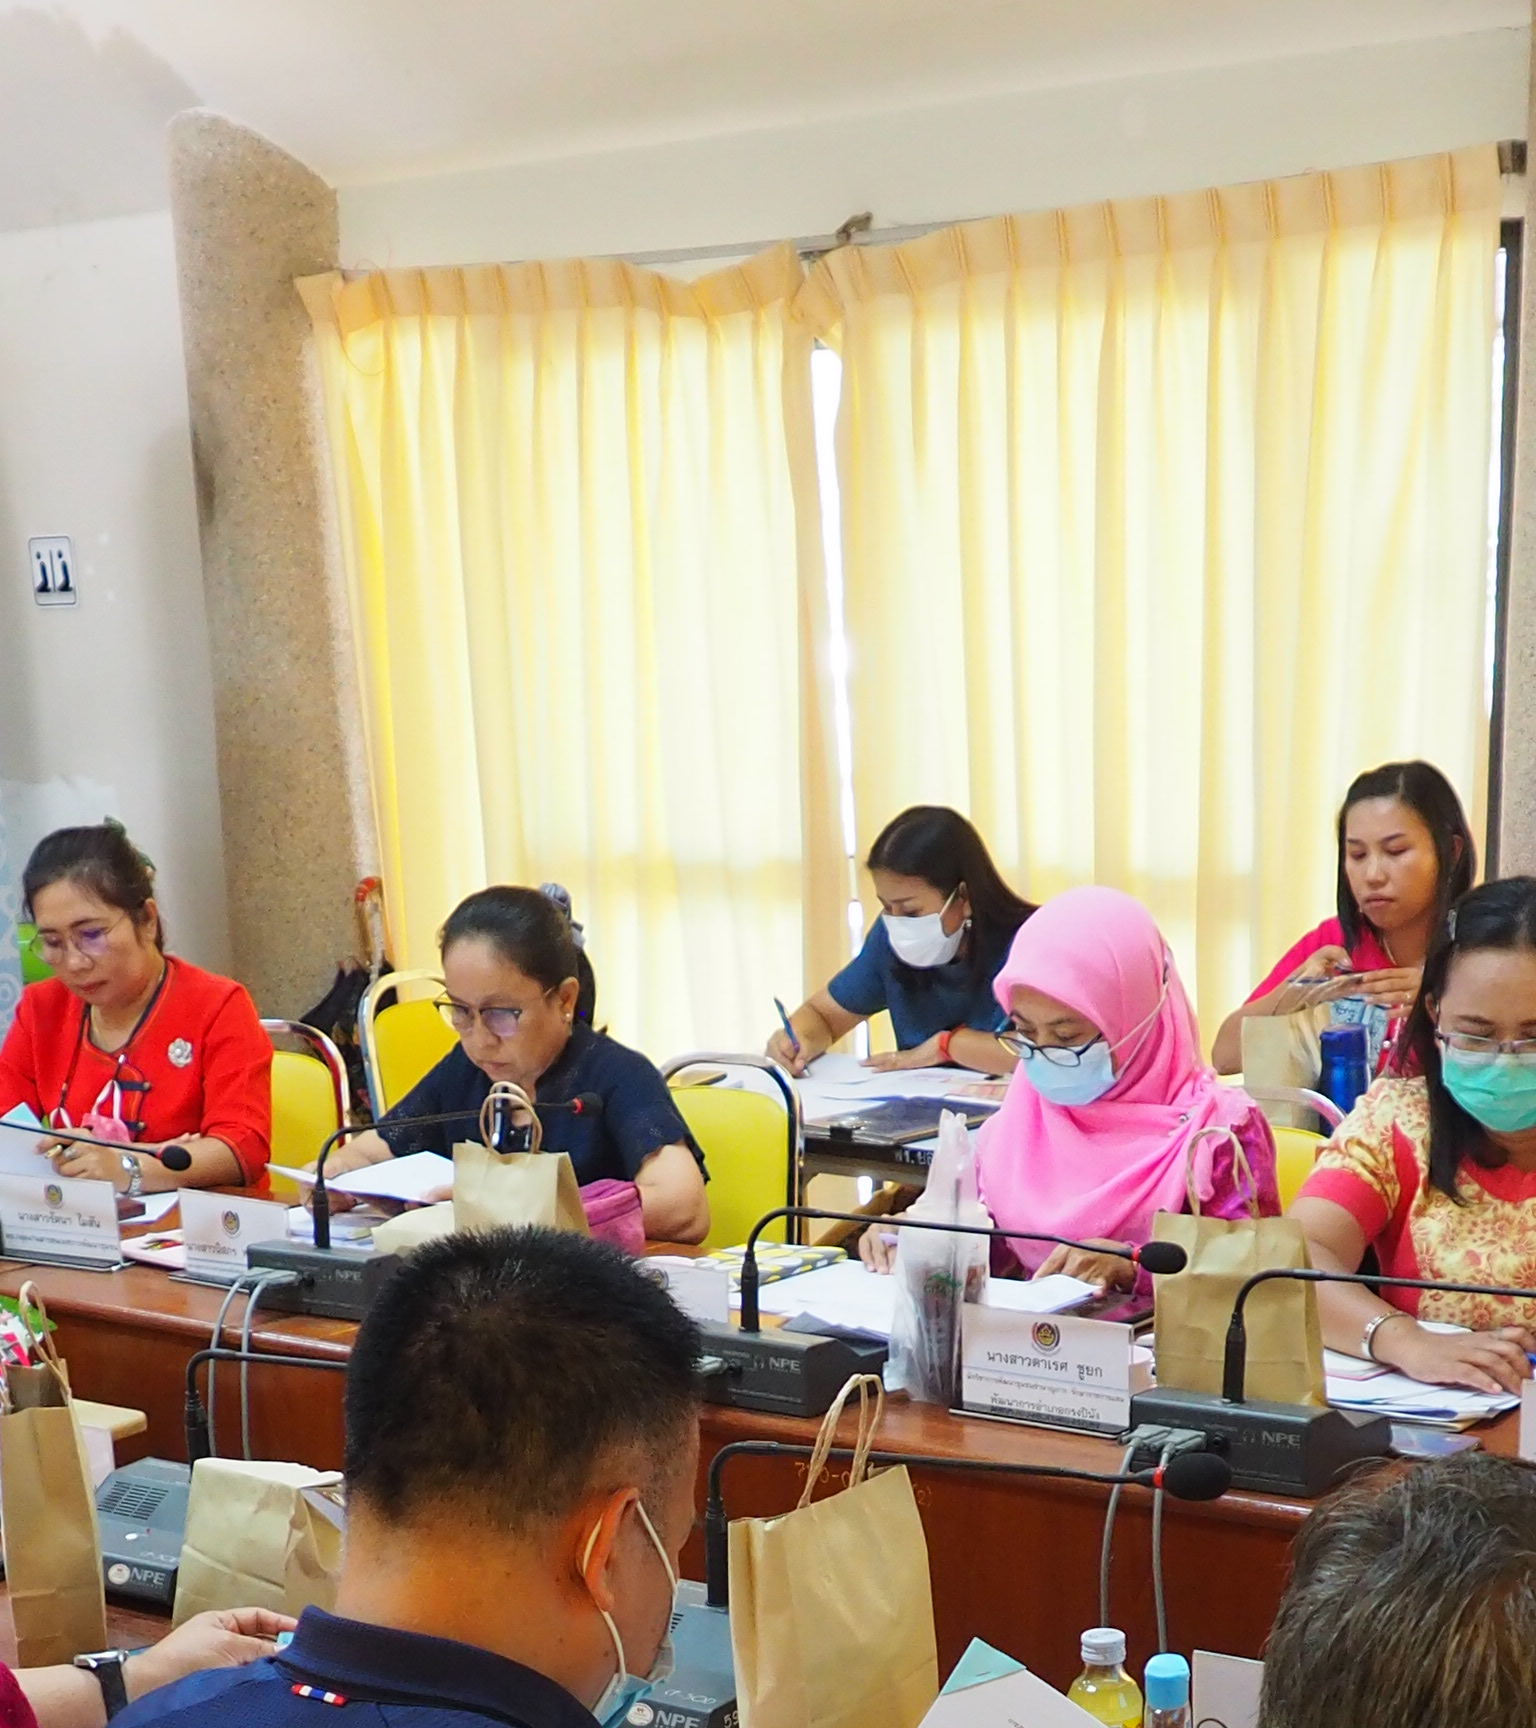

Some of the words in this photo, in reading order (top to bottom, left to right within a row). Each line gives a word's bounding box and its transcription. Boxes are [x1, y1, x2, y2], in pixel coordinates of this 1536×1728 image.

[769, 1356, 801, 1371] NPE
[1261, 1430, 1302, 1446] NPE
[129, 1566, 167, 1584] NPE
